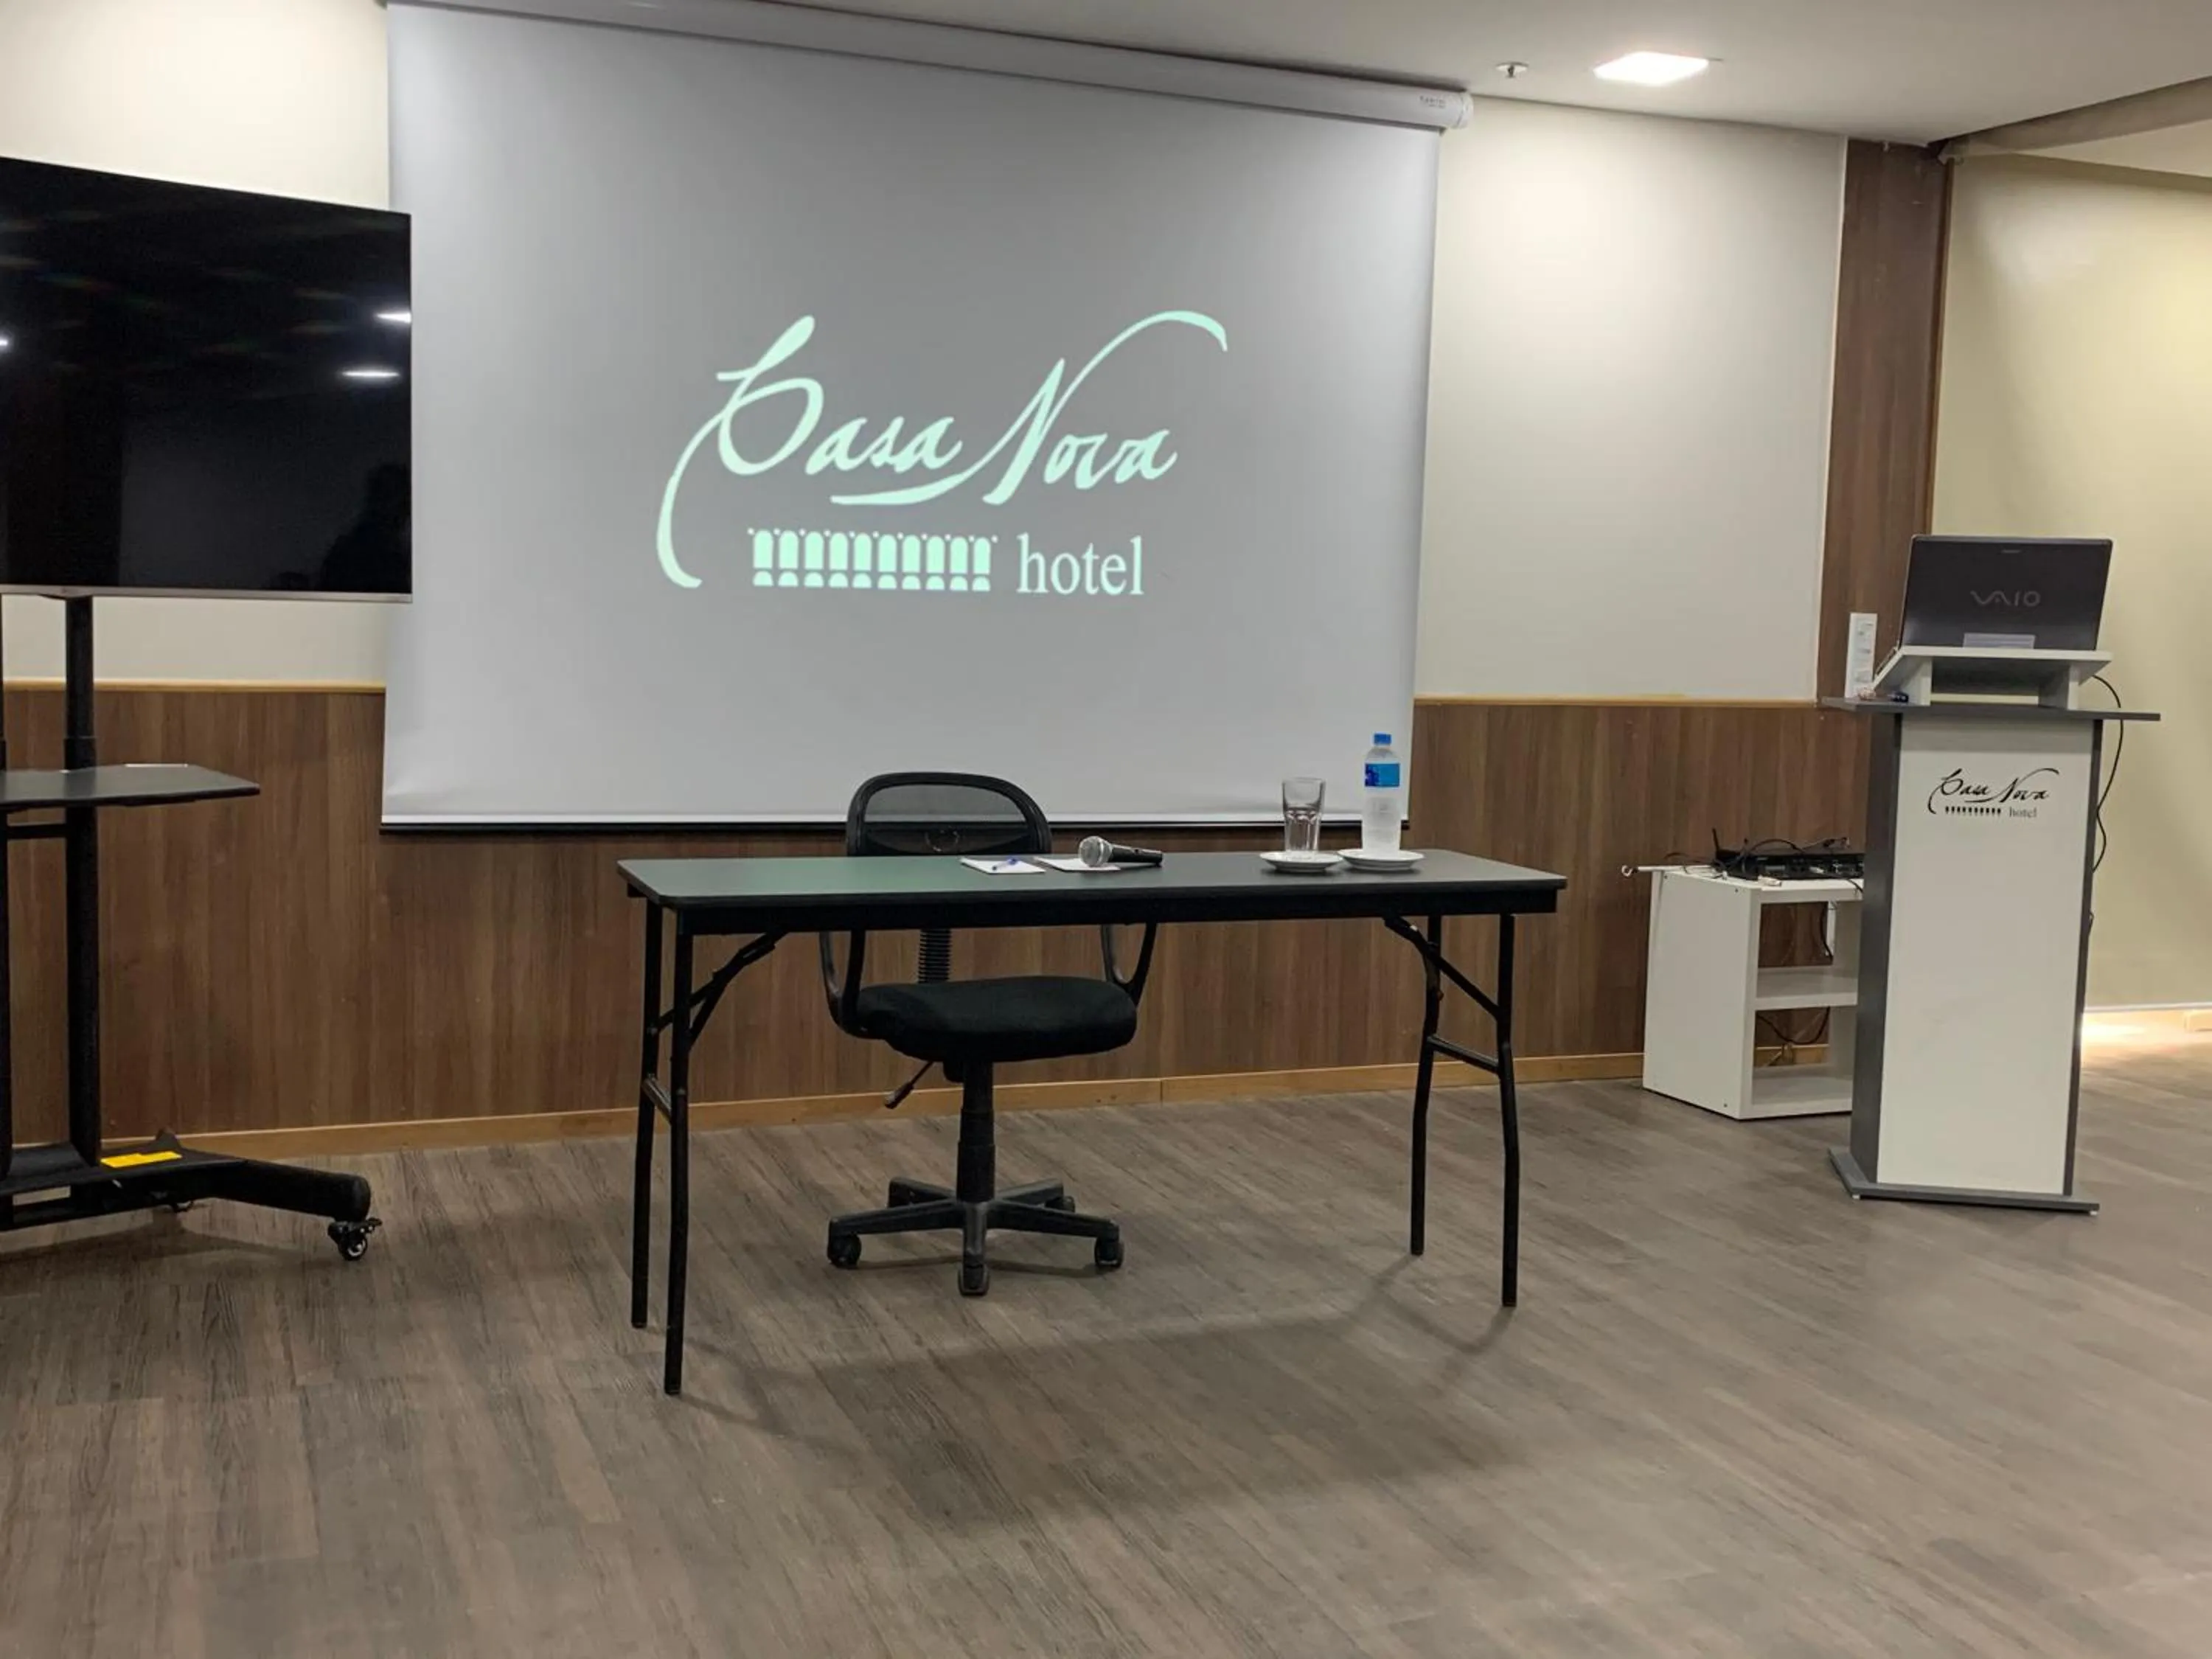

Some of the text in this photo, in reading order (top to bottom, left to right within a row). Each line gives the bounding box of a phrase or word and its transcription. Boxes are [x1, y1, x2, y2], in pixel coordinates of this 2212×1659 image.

[655, 310, 1229, 589] Casa Nova
[1016, 532, 1145, 597] hotel
[1969, 590, 2041, 607] VAIO
